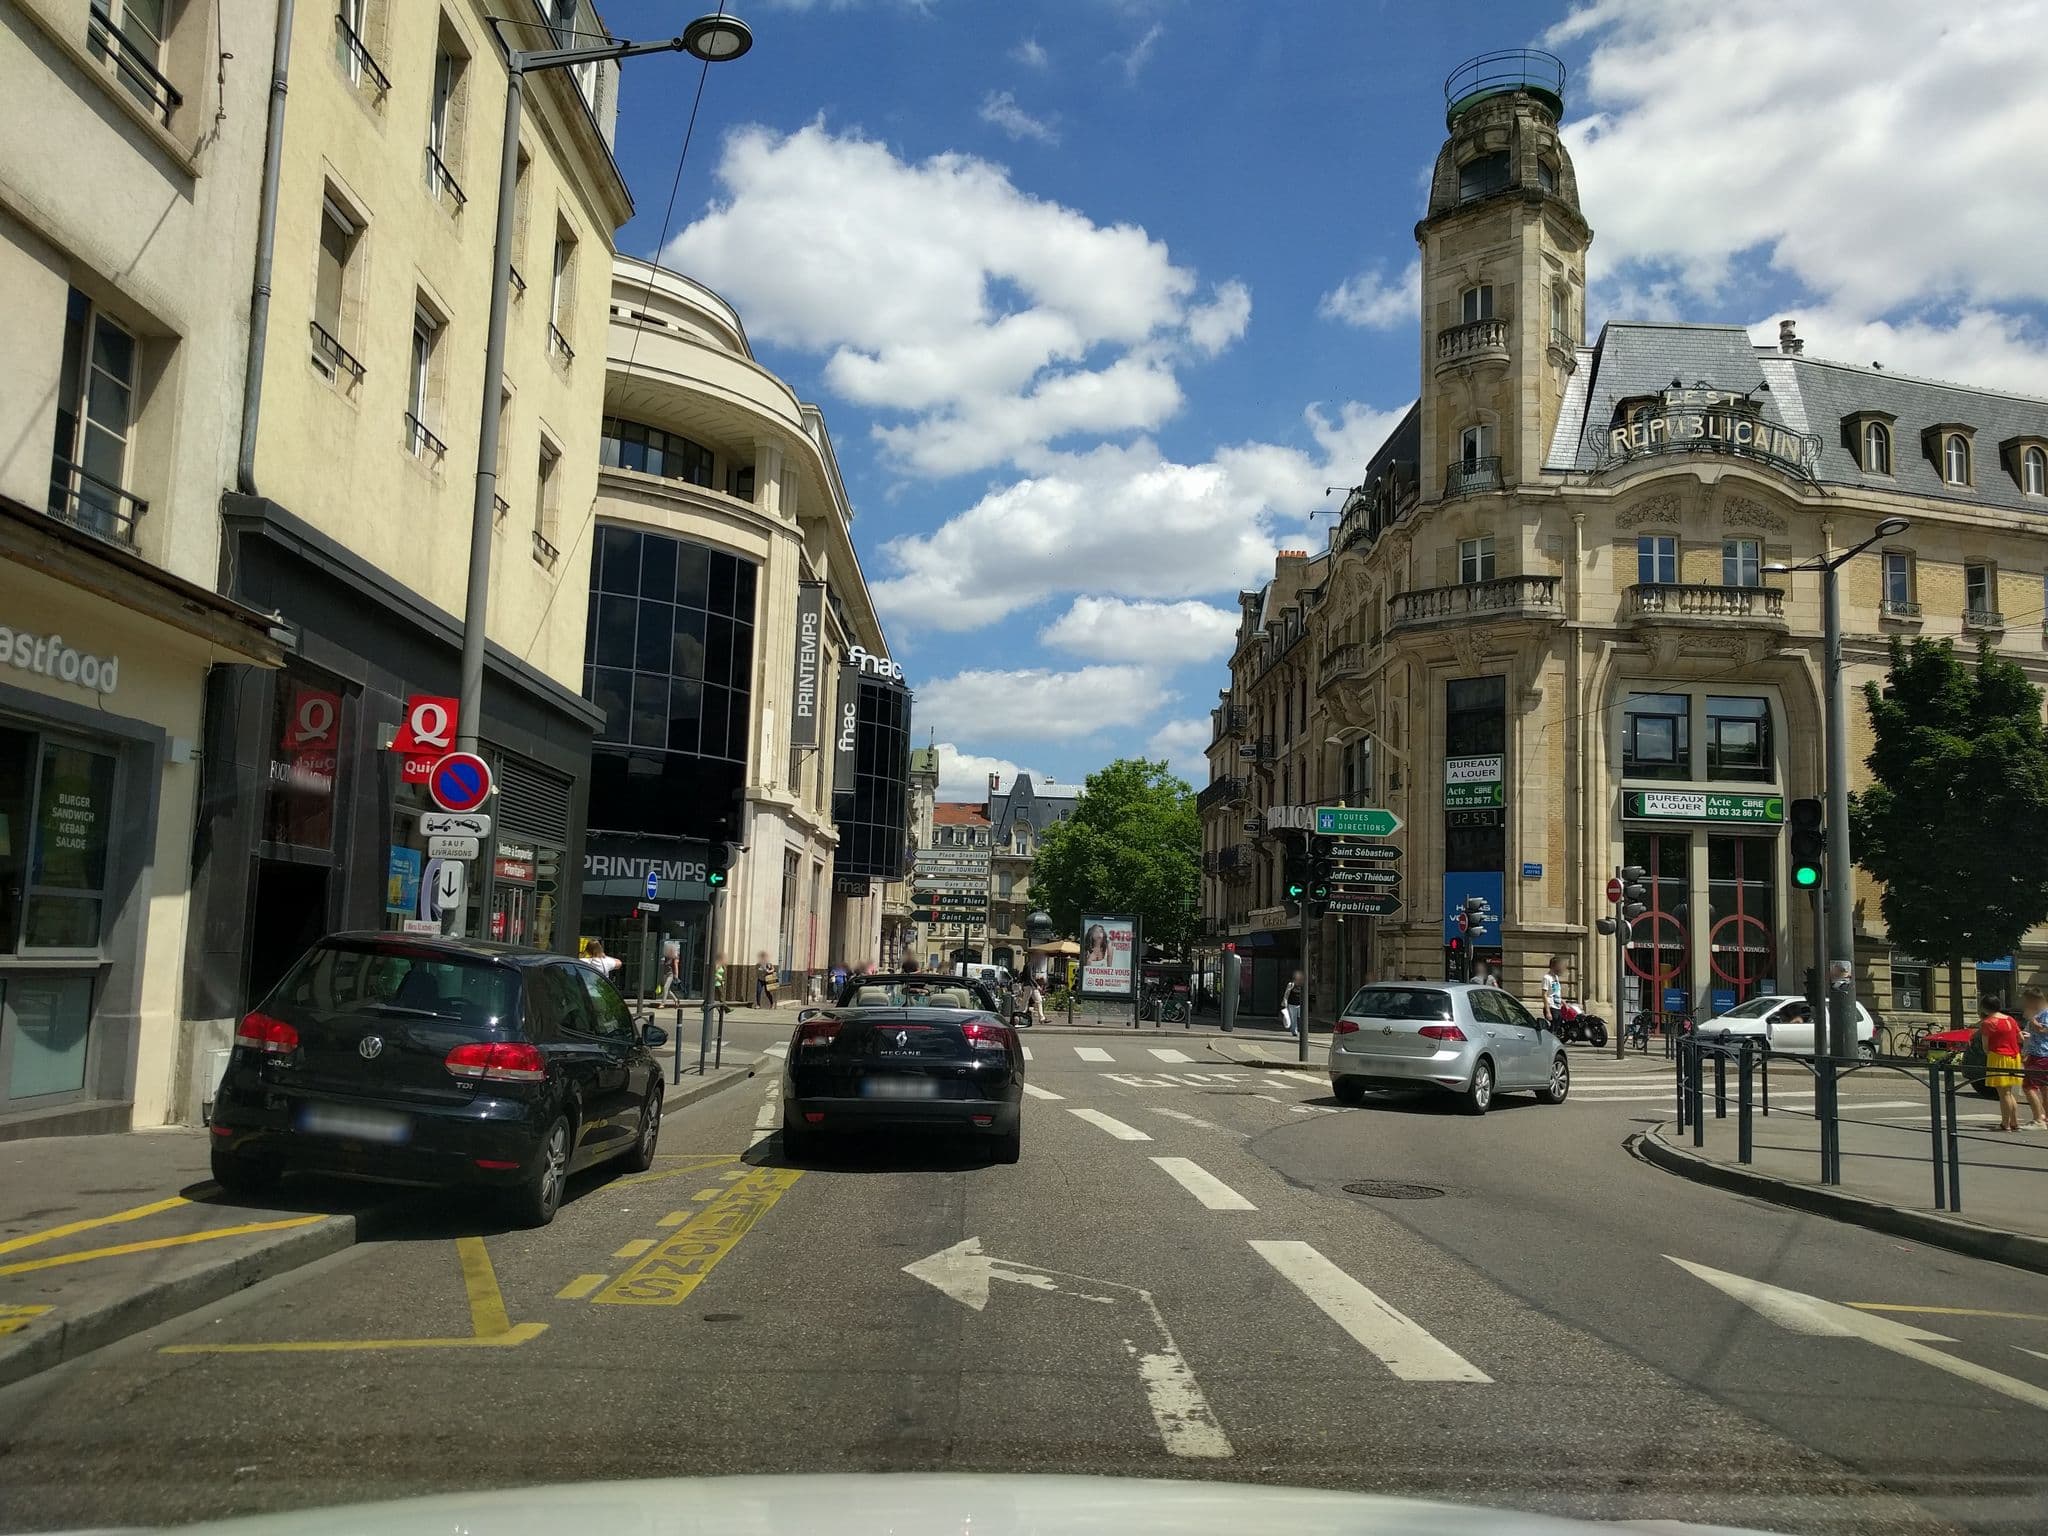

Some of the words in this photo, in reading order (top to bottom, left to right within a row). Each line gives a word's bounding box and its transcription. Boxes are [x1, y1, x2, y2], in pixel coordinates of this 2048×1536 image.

[798, 612, 817, 717] PRINTEMPS
[848, 645, 904, 680] fnac
[411, 704, 450, 748] Q
[838, 702, 856, 752] fnac
[405, 760, 436, 775] Qui
[1449, 759, 1498, 769] BUREAUX
[1461, 769, 1496, 778] LOUER
[1447, 786, 1466, 795] Acte
[59, 793, 91, 808] BURGER
[1464, 797, 1473, 805] 32
[1483, 796, 1492, 804] 77
[1647, 794, 1704, 803] BUREAUX
[1708, 797, 1732, 807] Acte
[1742, 800, 1764, 808] CBRE
[1661, 802, 1701, 811] LOUER
[51, 806, 95, 823] SANDWICH
[1339, 813, 1369, 821] TOUTES
[1708, 808, 1718, 816] 03
[1719, 808, 1729, 816] 83
[1731, 808, 1741, 817] 32
[1742, 809, 1752, 817] 86
[59, 822, 86, 836] KEBAB
[1338, 823, 1386, 832] DIRECTIONS
[55, 836, 87, 850] SALADE
[442, 840, 465, 848] SAUF
[432, 849, 473, 857] LIVRAISONS
[1331, 847, 1353, 856] Saint
[1355, 847, 1394, 858] Sébastien
[1364, 872, 1395, 882] Thiébaut
[837, 877, 866, 895] fnac
[963, 897, 985, 905] Thiers
[1329, 901, 1381, 913] République
[941, 913, 962, 921] Saint
[456, 1081, 474, 1090] TDI
